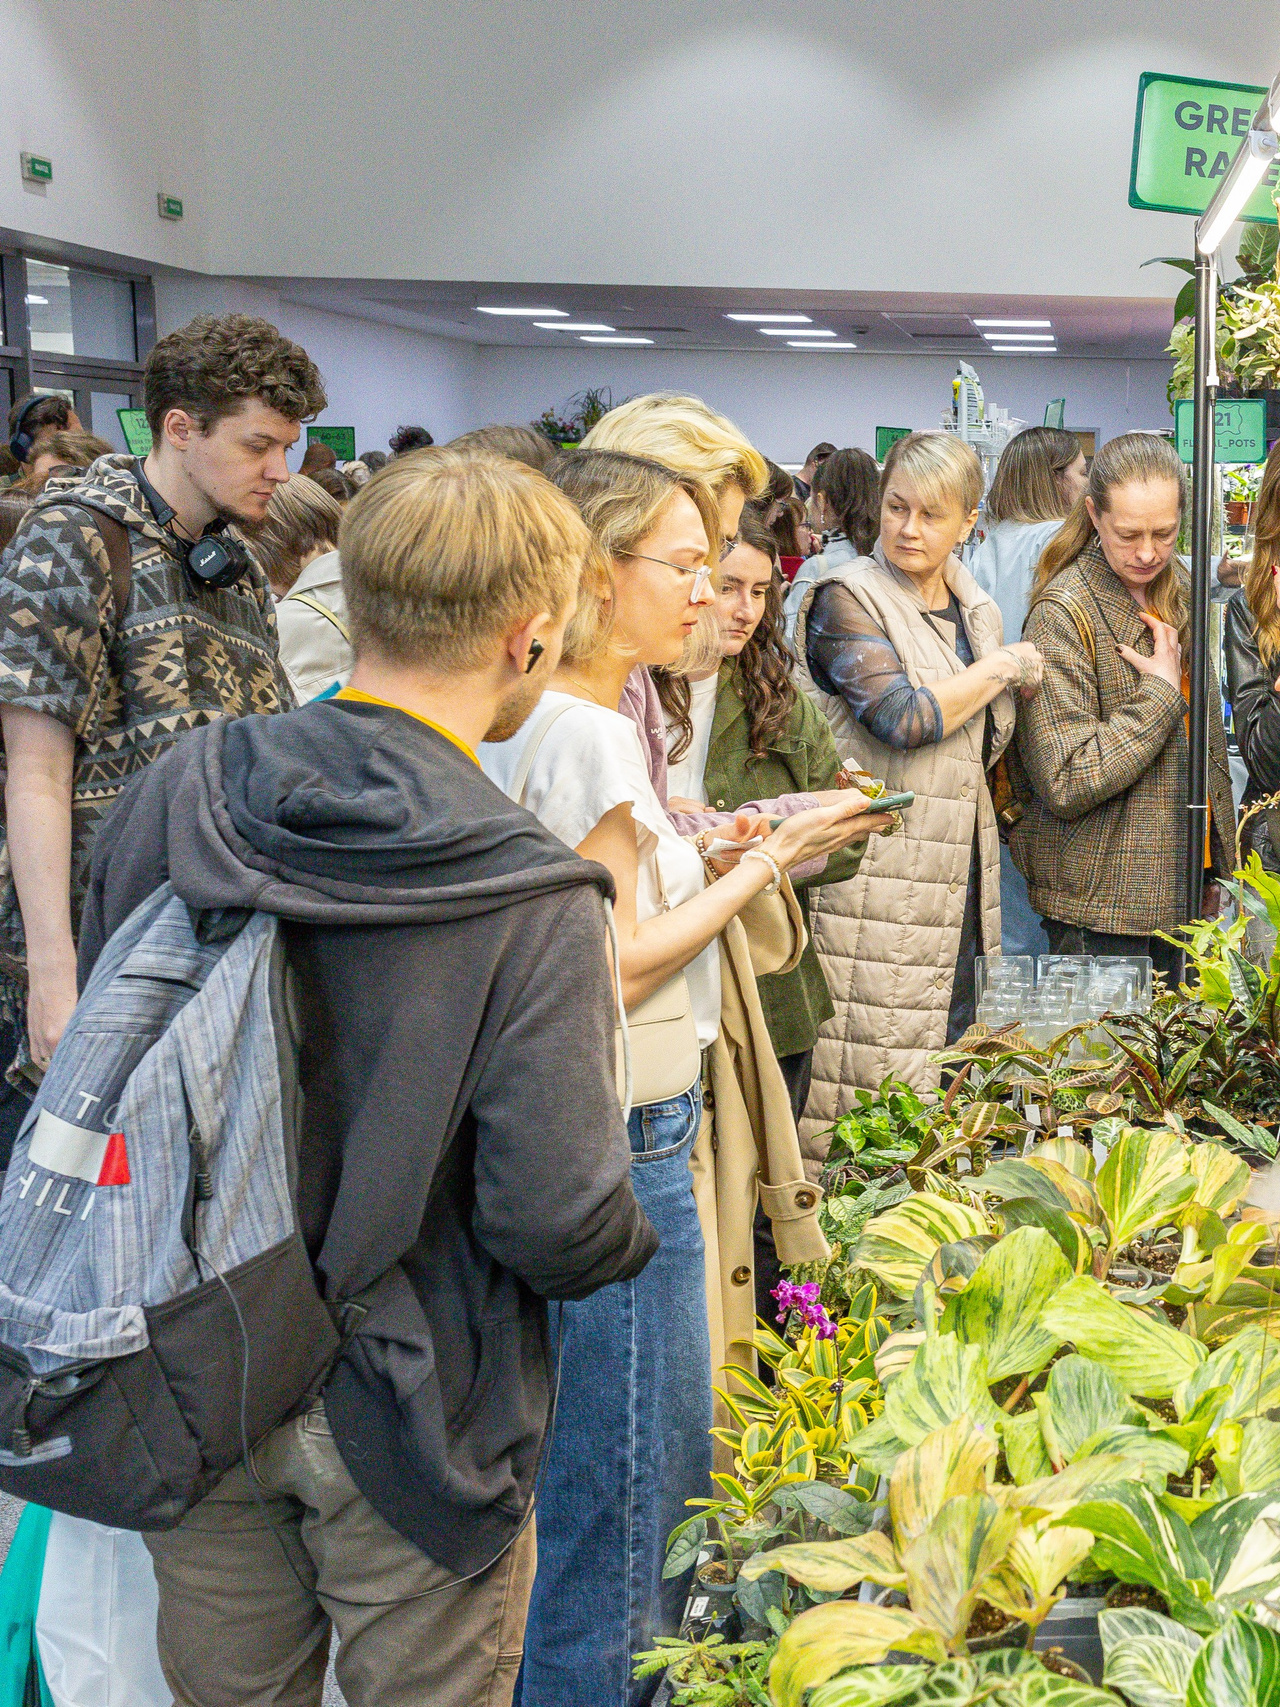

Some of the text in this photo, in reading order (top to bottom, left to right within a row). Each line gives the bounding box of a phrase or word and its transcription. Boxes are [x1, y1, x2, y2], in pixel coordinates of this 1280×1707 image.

[1174, 100, 1280, 139] GRE
[1184, 147, 1280, 187] RAE
[1215, 412, 1231, 426] 21
[1183, 439, 1256, 450] FLL_POTS
